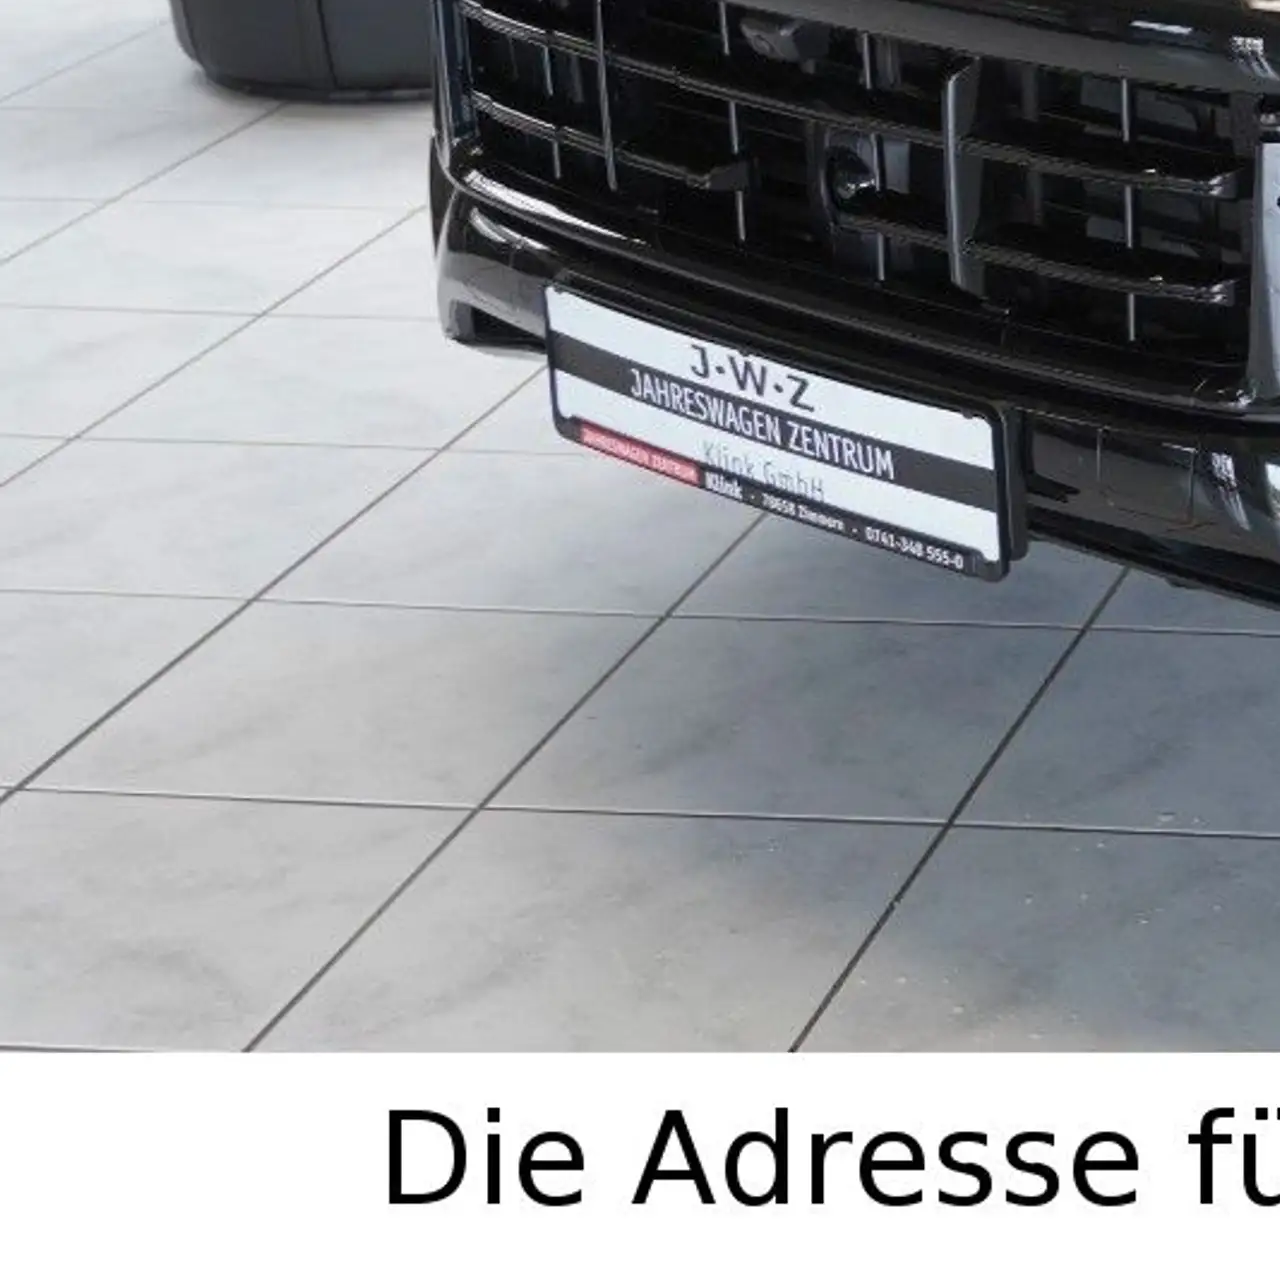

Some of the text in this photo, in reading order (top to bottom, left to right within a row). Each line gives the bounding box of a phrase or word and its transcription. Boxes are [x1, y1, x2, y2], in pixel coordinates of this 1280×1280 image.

[631, 368, 895, 480] JAHRESWAGEN ZENTRUM
[763, 461, 825, 501] GmbH
